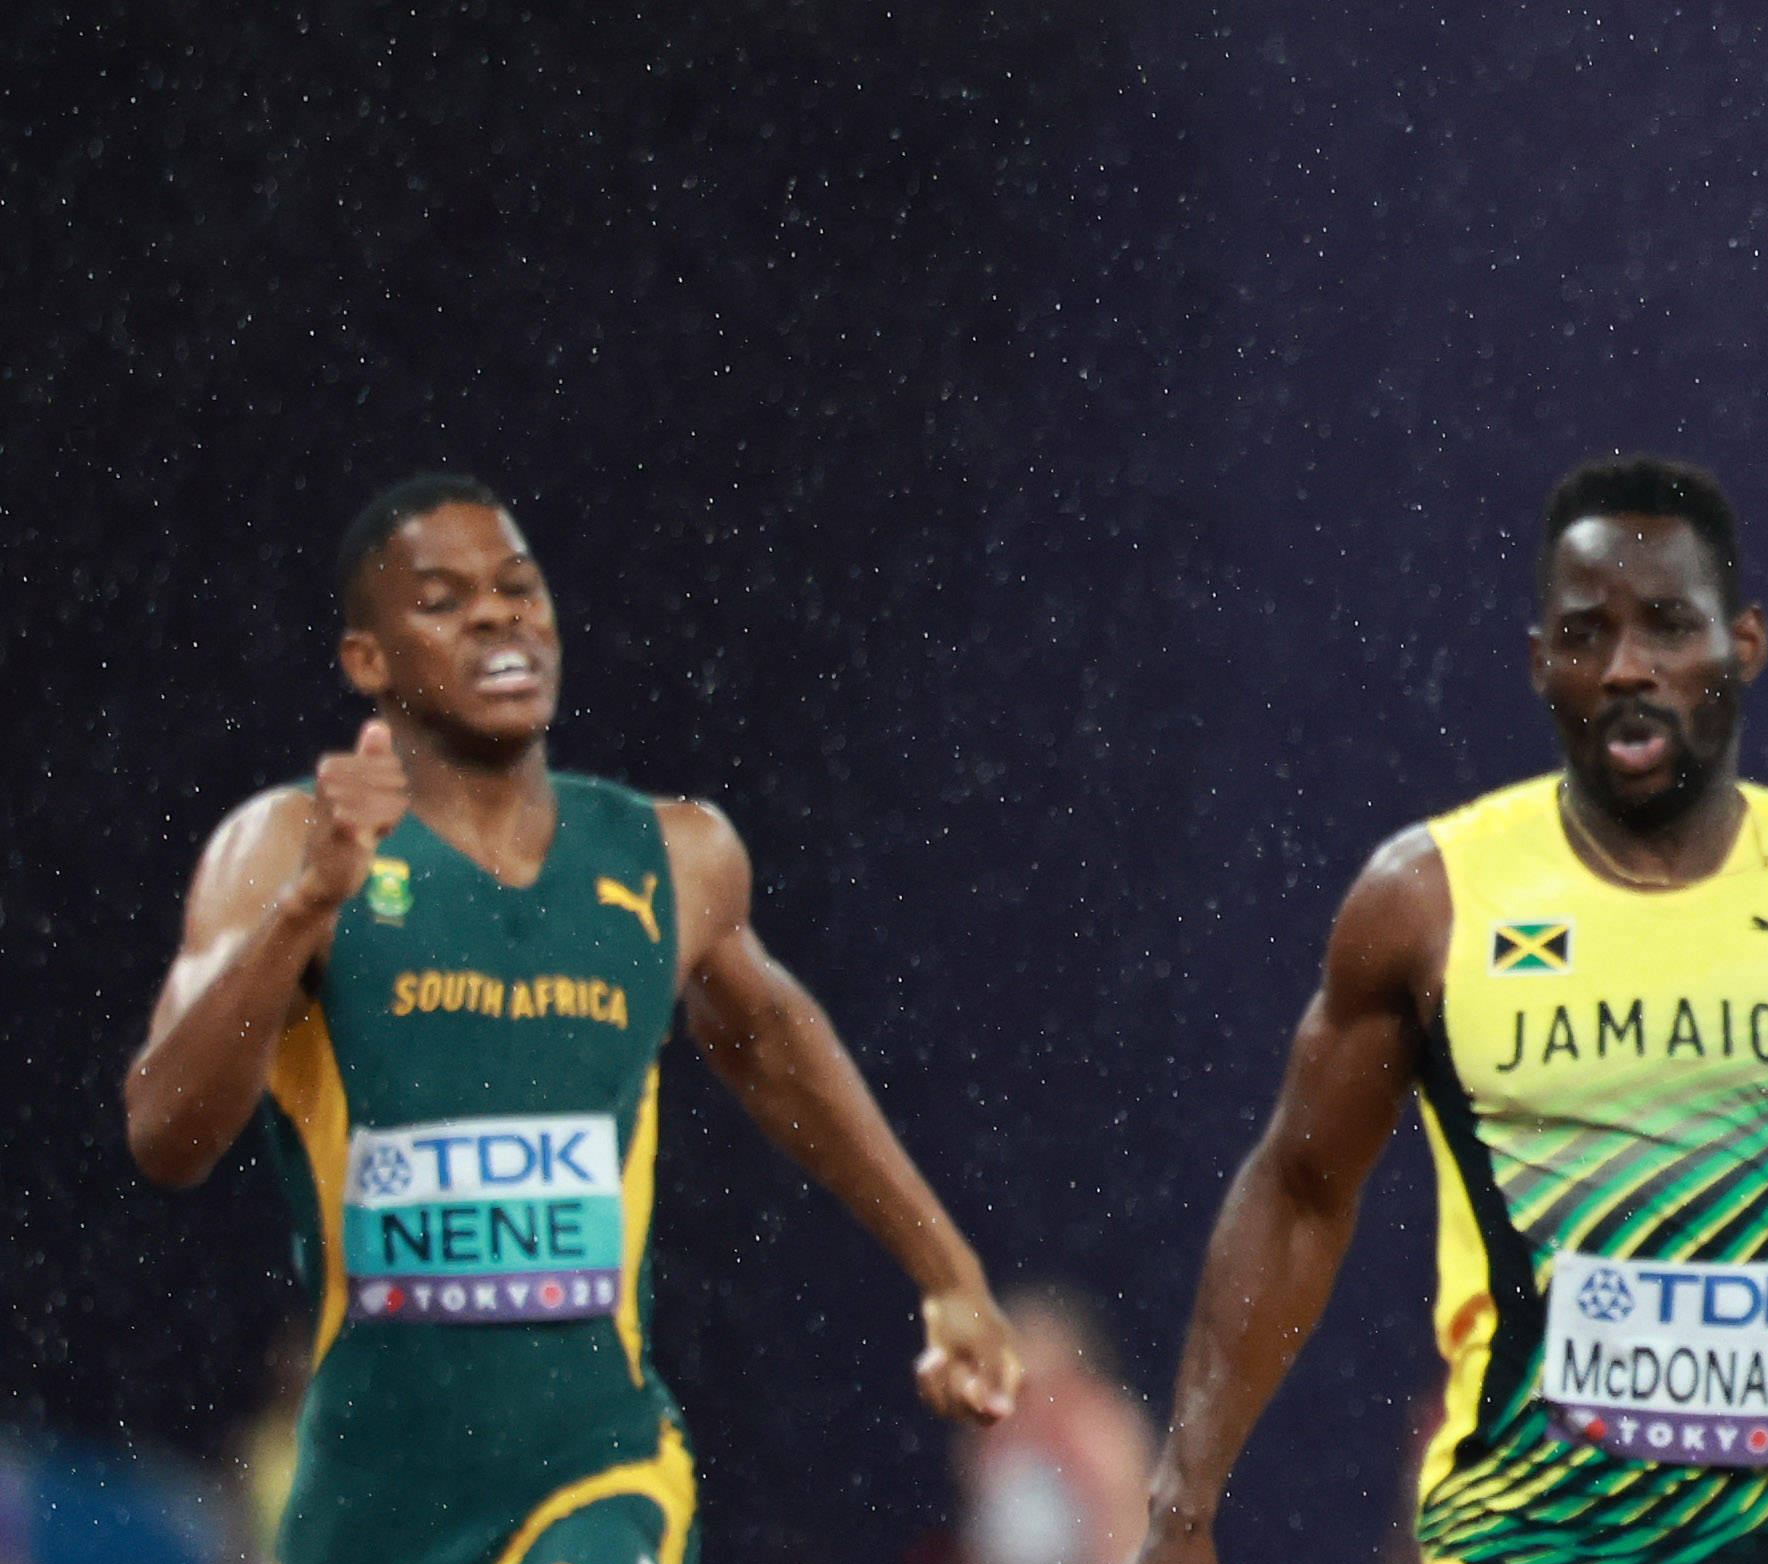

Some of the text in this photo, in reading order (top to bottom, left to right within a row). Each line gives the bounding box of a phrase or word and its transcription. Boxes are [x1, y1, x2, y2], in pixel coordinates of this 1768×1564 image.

[392, 969, 629, 1030] SOUTH AFRICA
[412, 1131, 592, 1190] TDK
[380, 1202, 584, 1264] NENE
